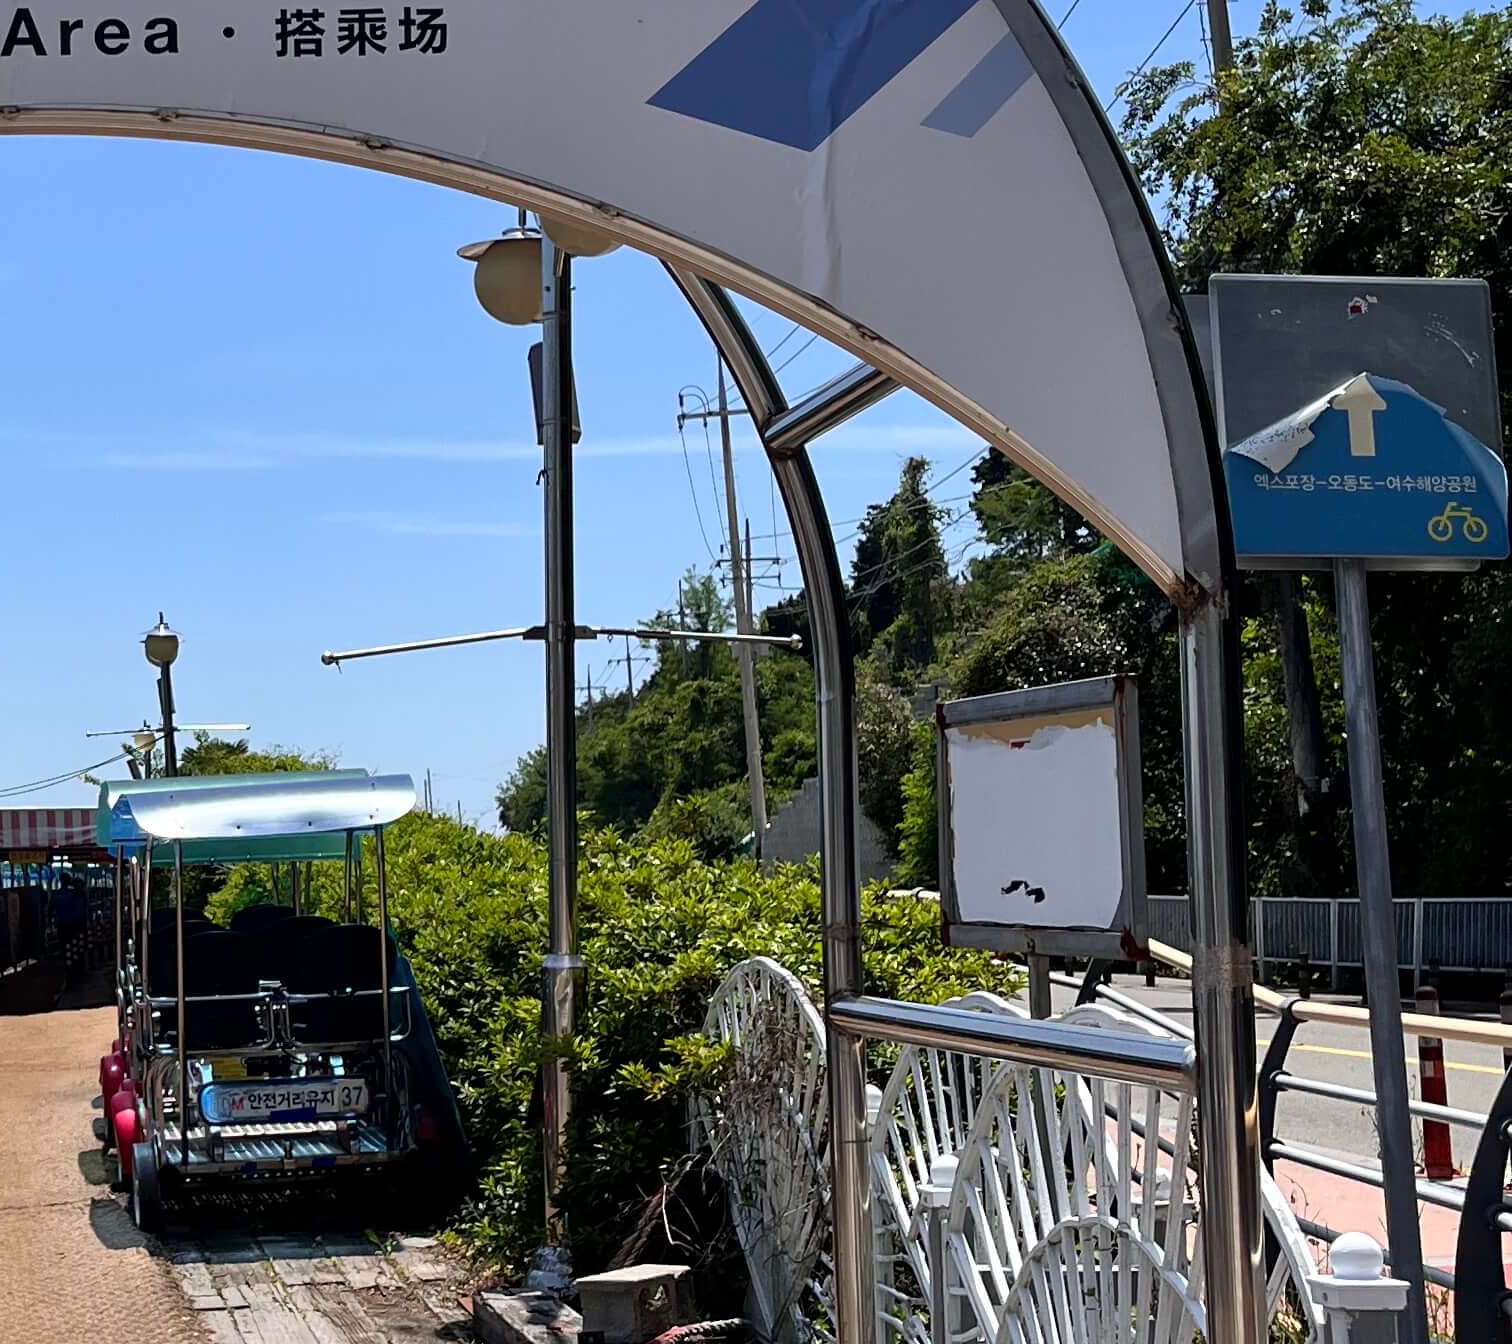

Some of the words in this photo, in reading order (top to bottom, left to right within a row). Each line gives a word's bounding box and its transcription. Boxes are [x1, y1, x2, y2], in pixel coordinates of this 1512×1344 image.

[0, 7, 180, 57] Area
[275, 6, 448, 58] 搭乘场
[341, 1086, 363, 1107] 37
